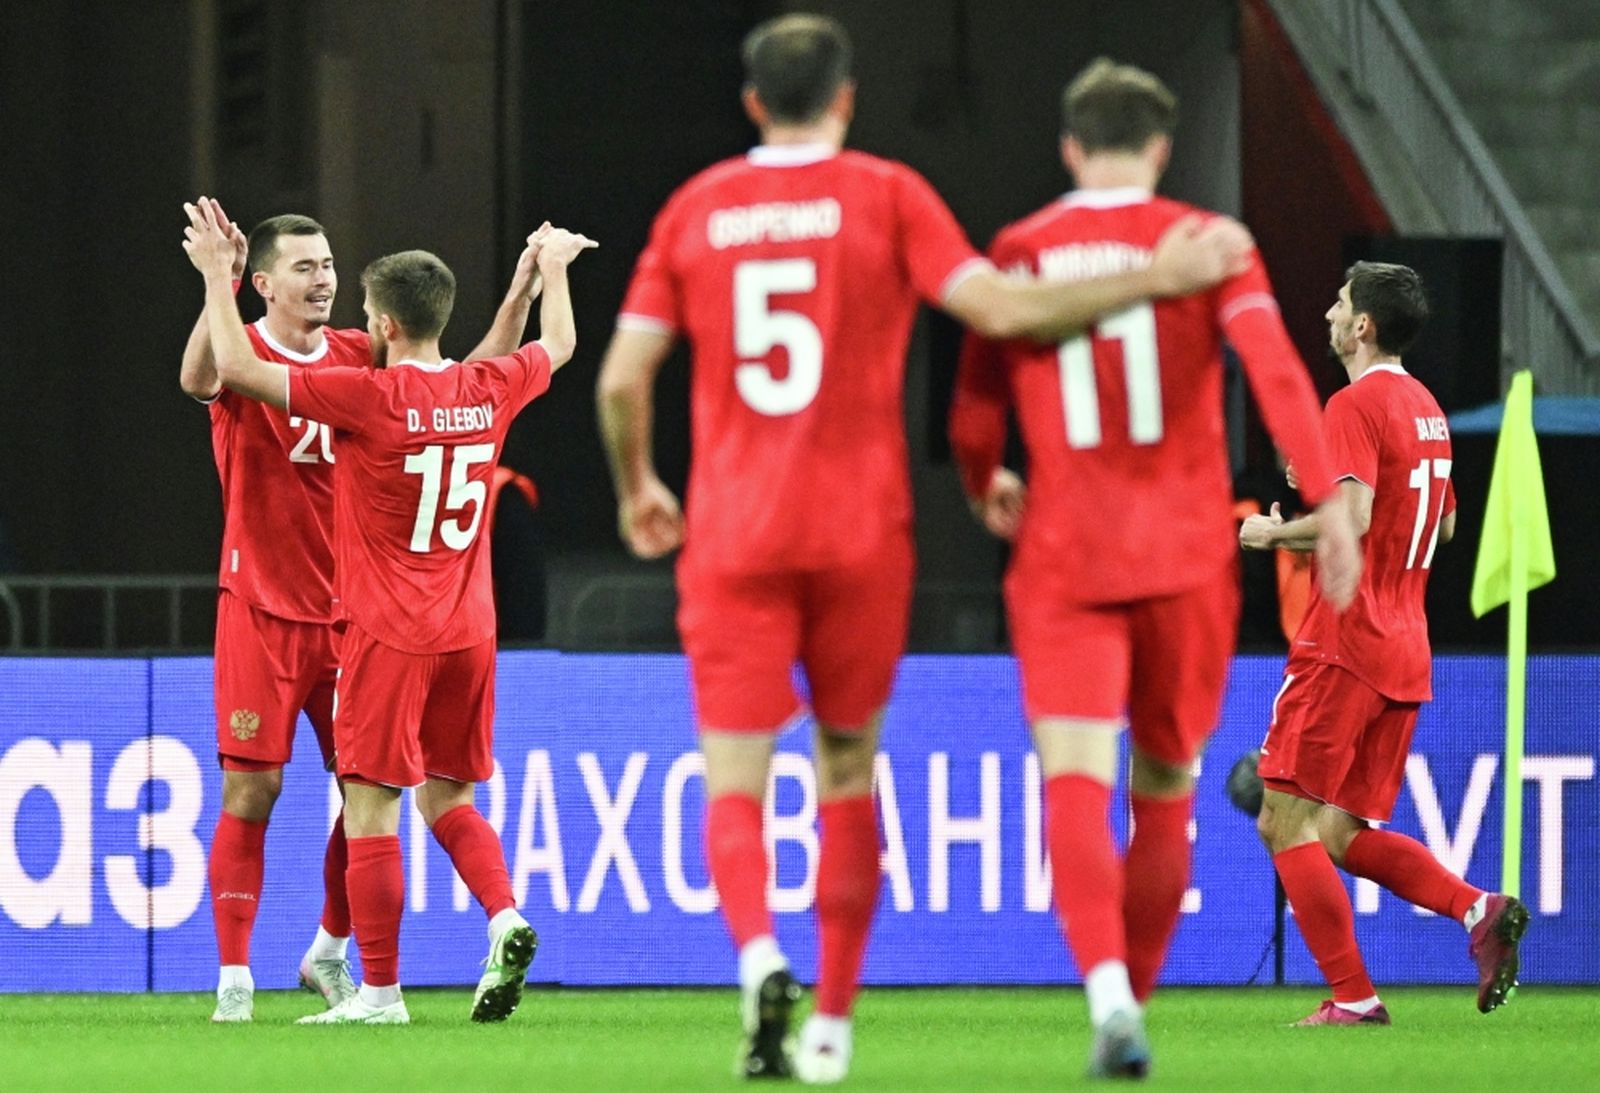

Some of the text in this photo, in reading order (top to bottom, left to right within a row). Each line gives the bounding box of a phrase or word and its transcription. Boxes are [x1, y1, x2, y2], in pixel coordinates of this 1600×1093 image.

[732, 256, 824, 417] 5
[1056, 300, 1164, 450] 11
[406, 403, 494, 433] D. GLEBOV
[403, 442, 496, 553] 15
[1405, 457, 1453, 571] 17
